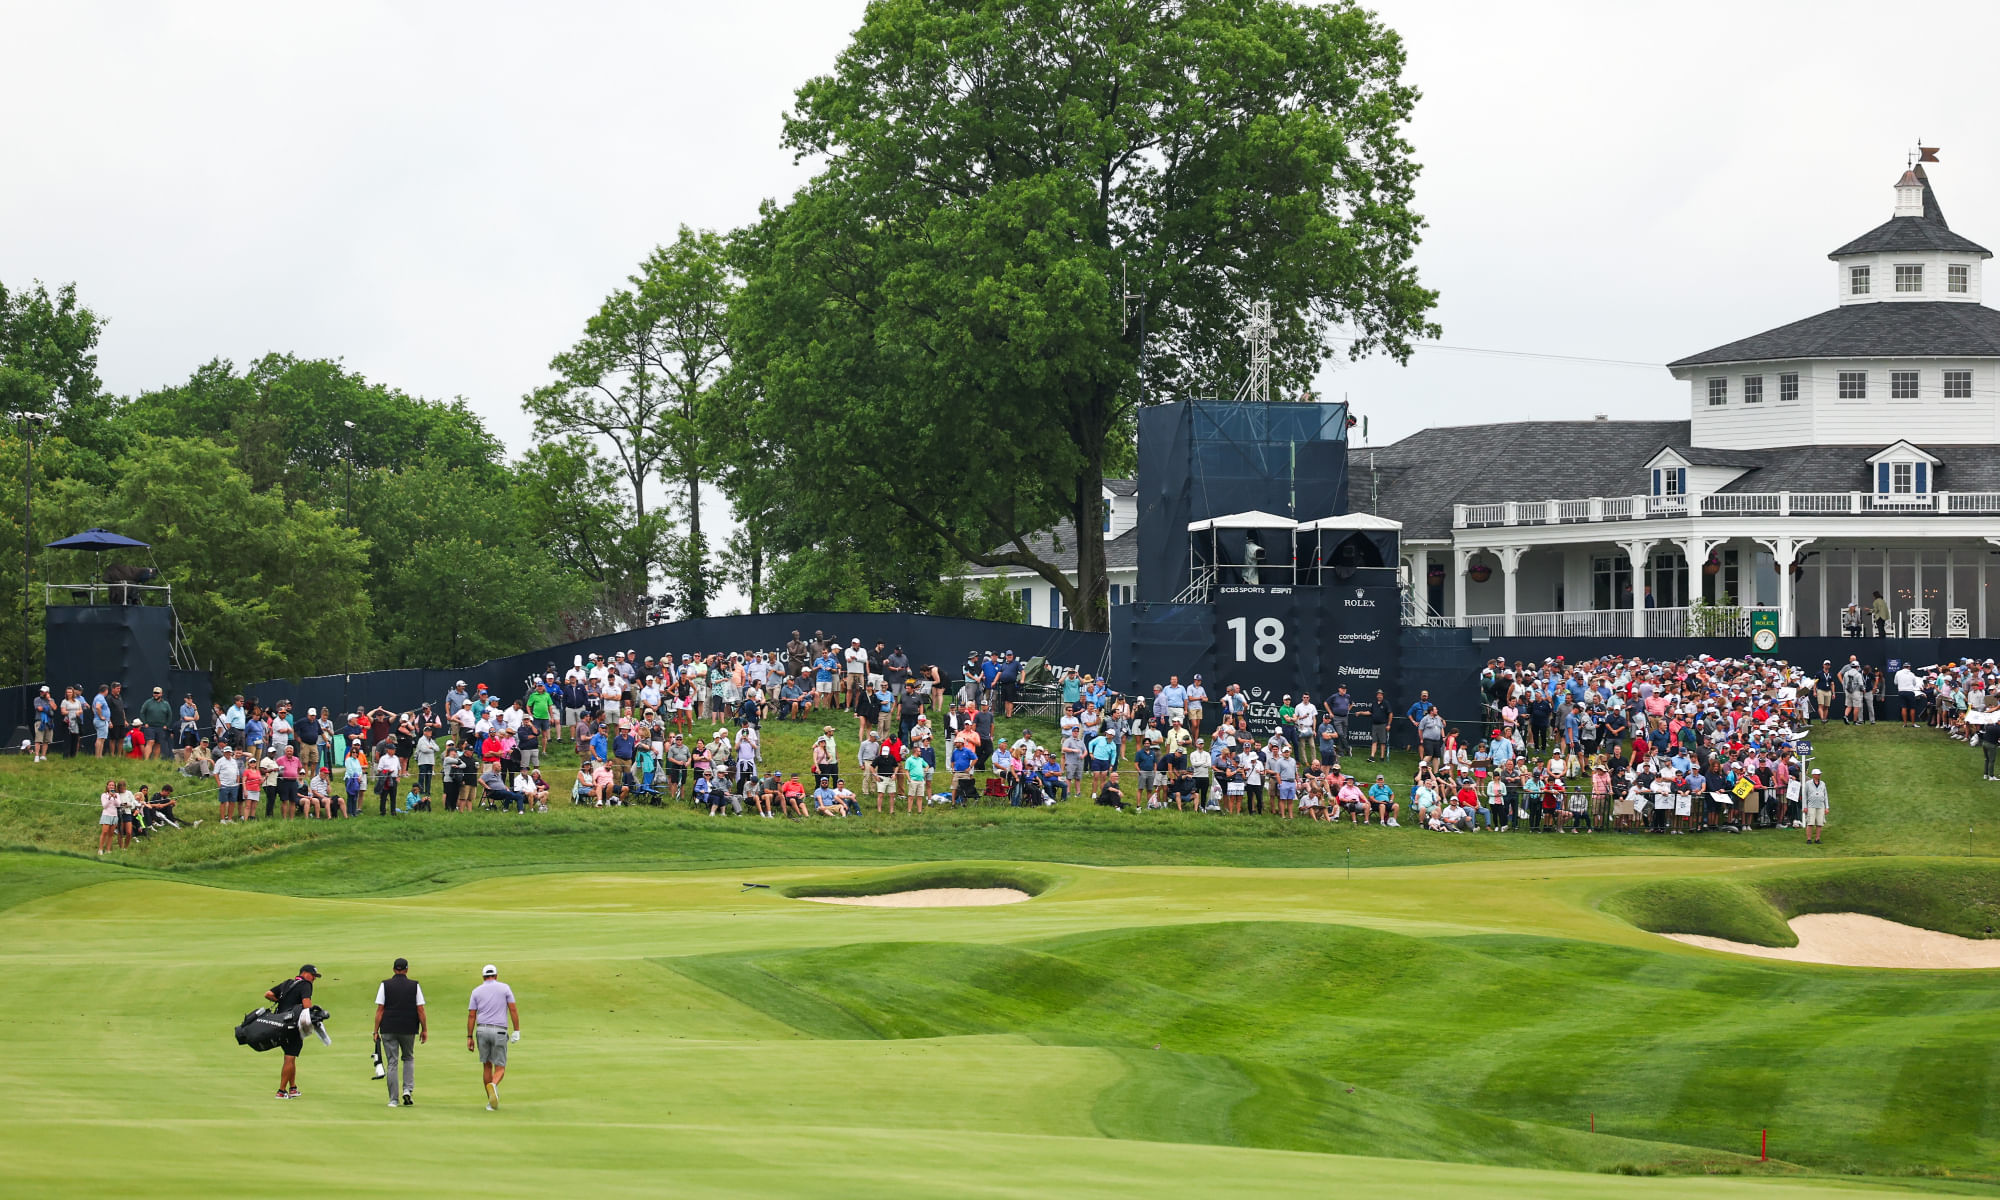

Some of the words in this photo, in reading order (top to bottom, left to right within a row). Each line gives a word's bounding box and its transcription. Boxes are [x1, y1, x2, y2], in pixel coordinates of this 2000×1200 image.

[1239, 586, 1265, 594] SPORTS
[1270, 587, 1292, 595] ESPN
[1344, 599, 1376, 607] ROLEX
[1226, 616, 1286, 663] 18
[1338, 632, 1376, 642] corebridge
[1347, 666, 1381, 675] National
